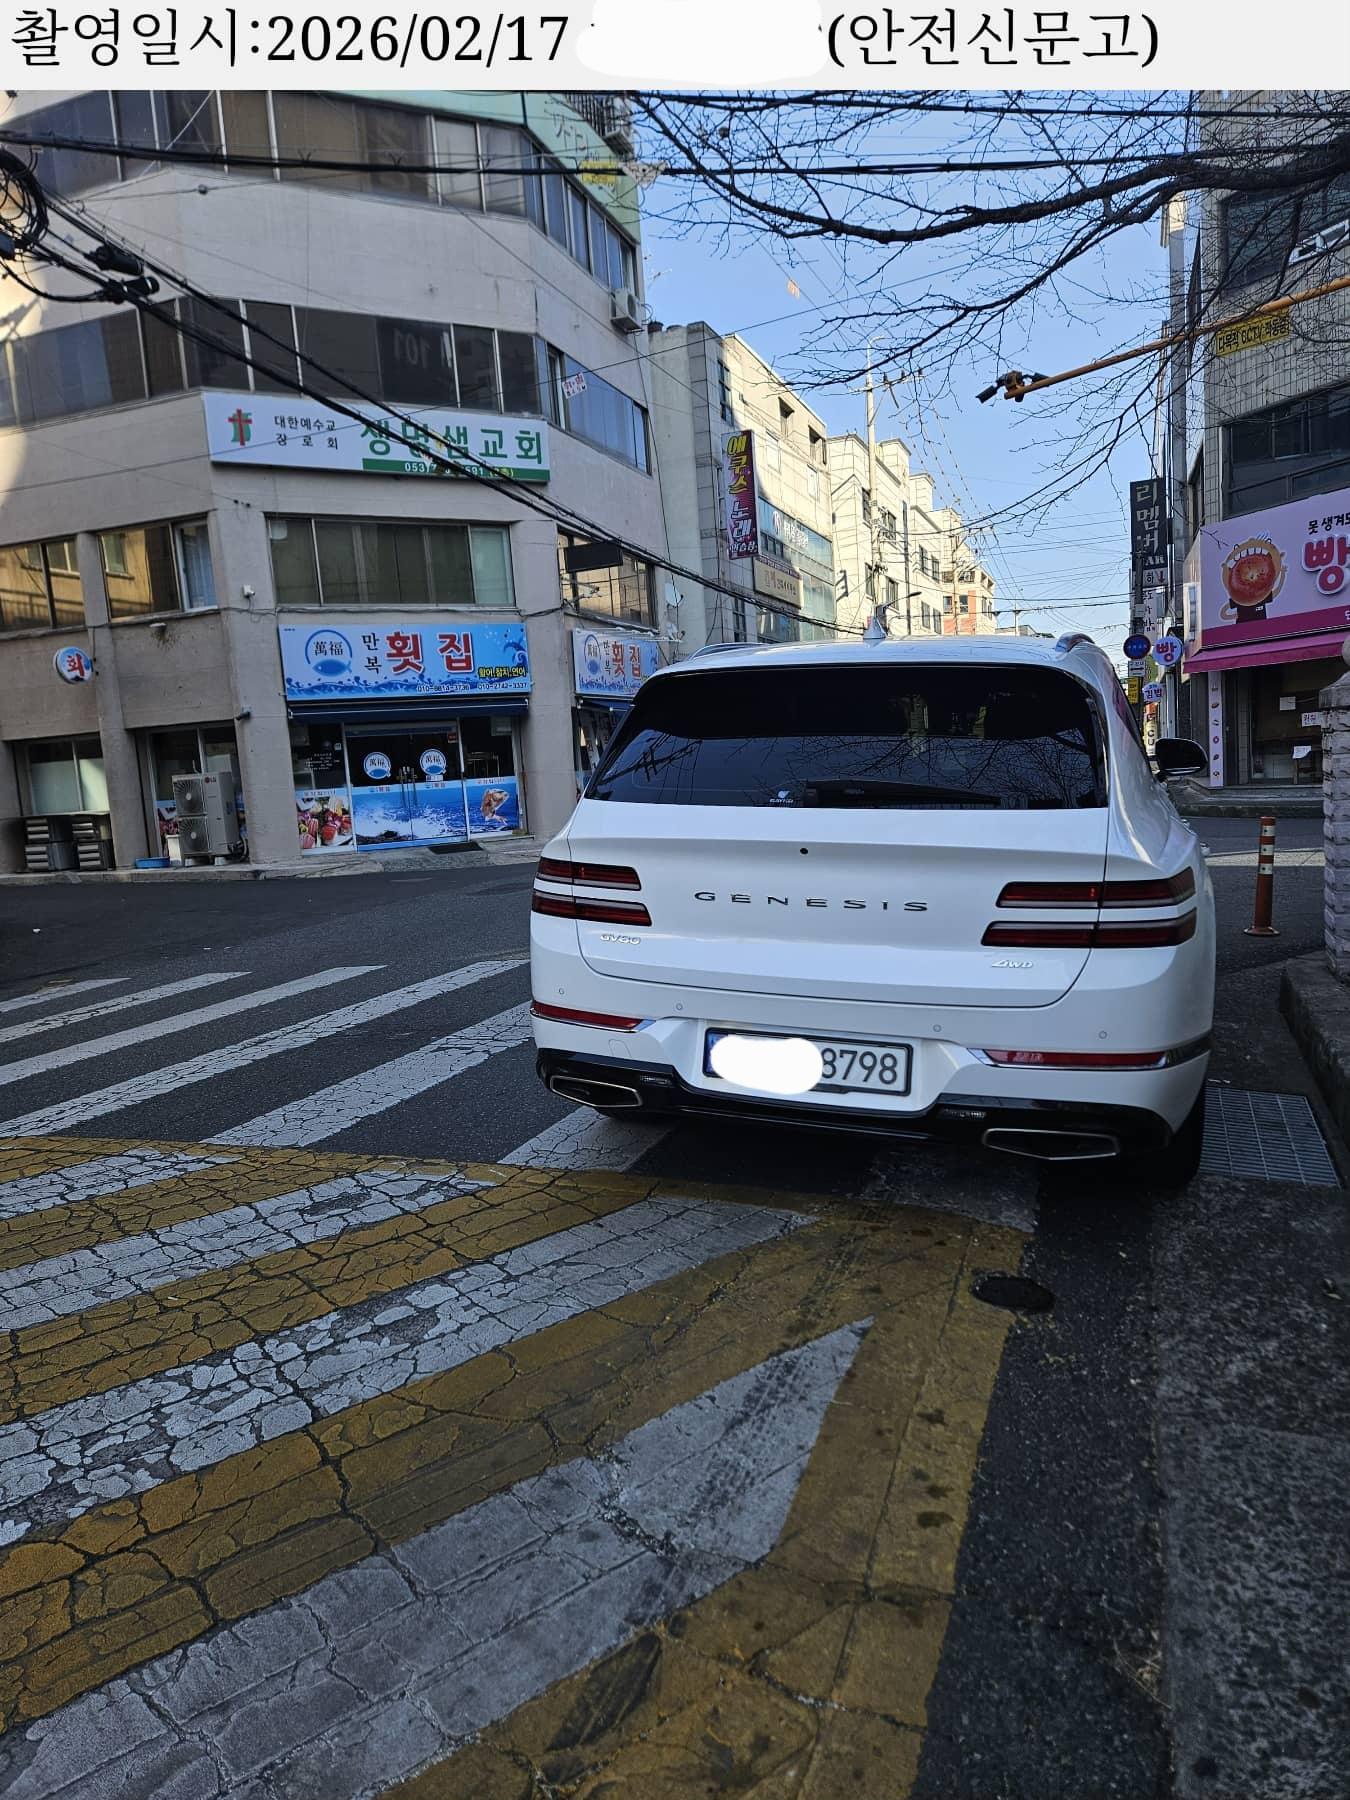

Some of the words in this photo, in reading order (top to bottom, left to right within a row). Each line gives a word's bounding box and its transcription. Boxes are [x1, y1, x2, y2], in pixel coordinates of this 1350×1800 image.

[274, 415, 336, 431] 대한예수교
[360, 420, 542, 465] 생명샘교회
[1303, 536, 1350, 592] 빵
[1156, 642, 1177, 662] 빵
[1145, 688, 1162, 699] 김밥
[694, 891, 929, 912] GENESIS
[821, 1047, 898, 1085] 8798
